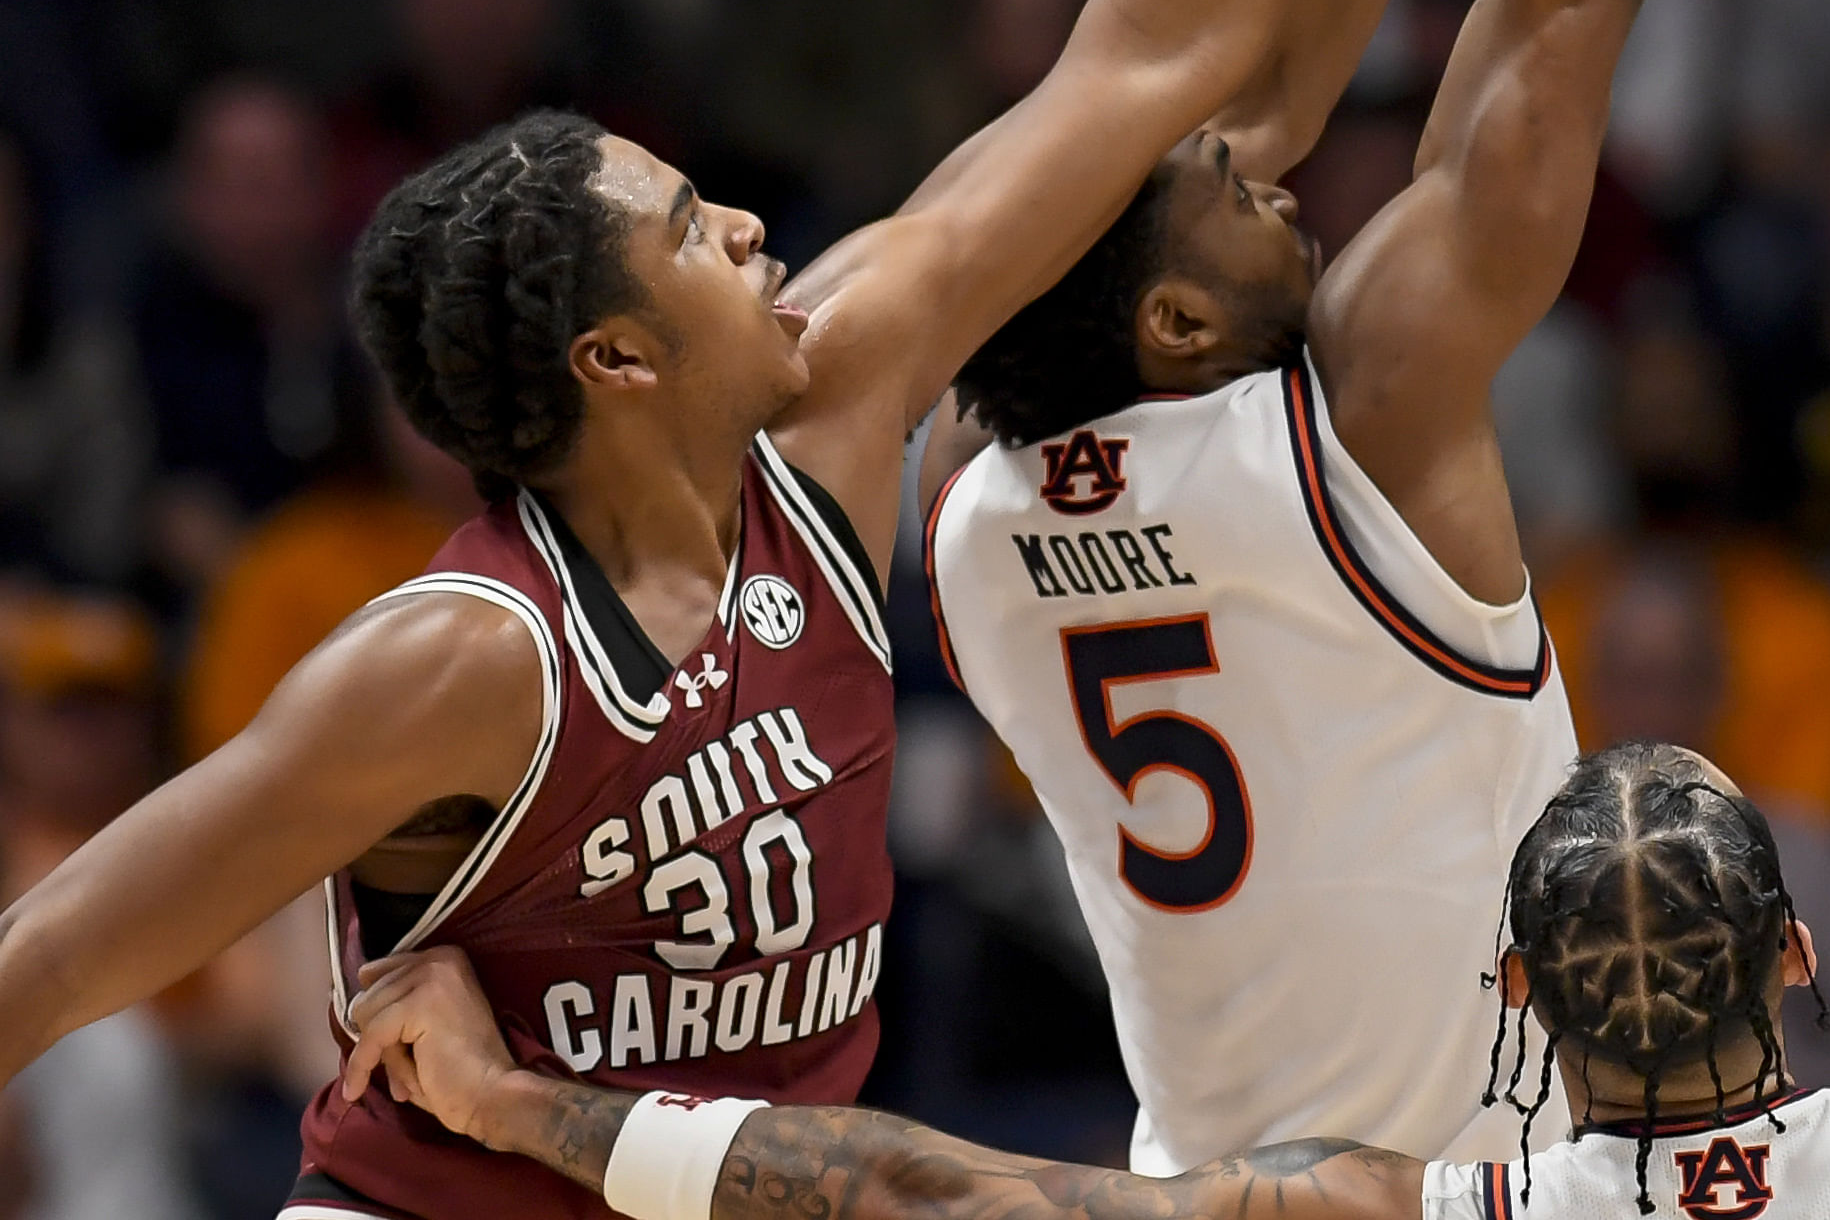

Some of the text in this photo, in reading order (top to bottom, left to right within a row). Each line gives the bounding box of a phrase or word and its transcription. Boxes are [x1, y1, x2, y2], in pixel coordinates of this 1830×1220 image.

[746, 579, 802, 645] SEC
[1011, 522, 1197, 598] MOORE
[580, 706, 833, 897] SOUTH
[1059, 611, 1254, 914] 5
[643, 810, 816, 970] 30
[543, 922, 883, 1074] CAROLINA
